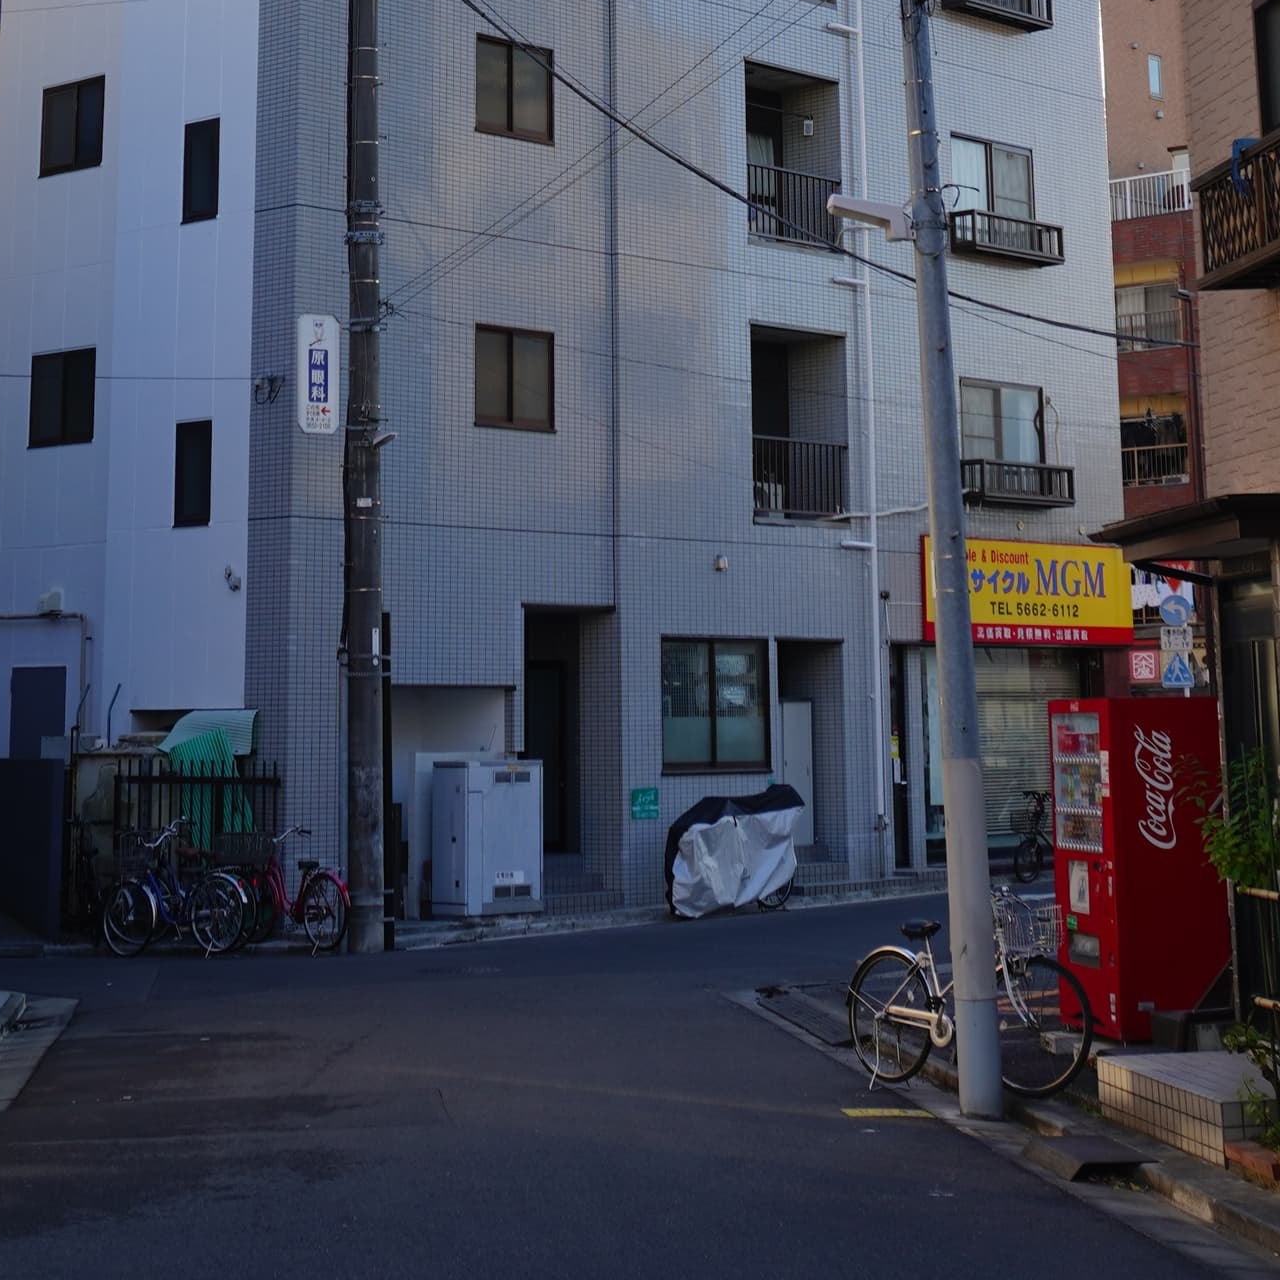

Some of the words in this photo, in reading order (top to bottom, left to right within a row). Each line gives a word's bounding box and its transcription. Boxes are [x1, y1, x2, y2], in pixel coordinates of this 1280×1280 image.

[311, 351, 325, 402] 原眼科
[981, 548, 987, 563] &
[991, 549, 1029, 565] Discount
[968, 568, 1031, 595] サイクル
[1034, 558, 1107, 599] MGM
[990, 601, 1012, 616] TEL
[1016, 601, 1080, 618] 5662-6112
[1133, 722, 1177, 850] Coca-Cola
